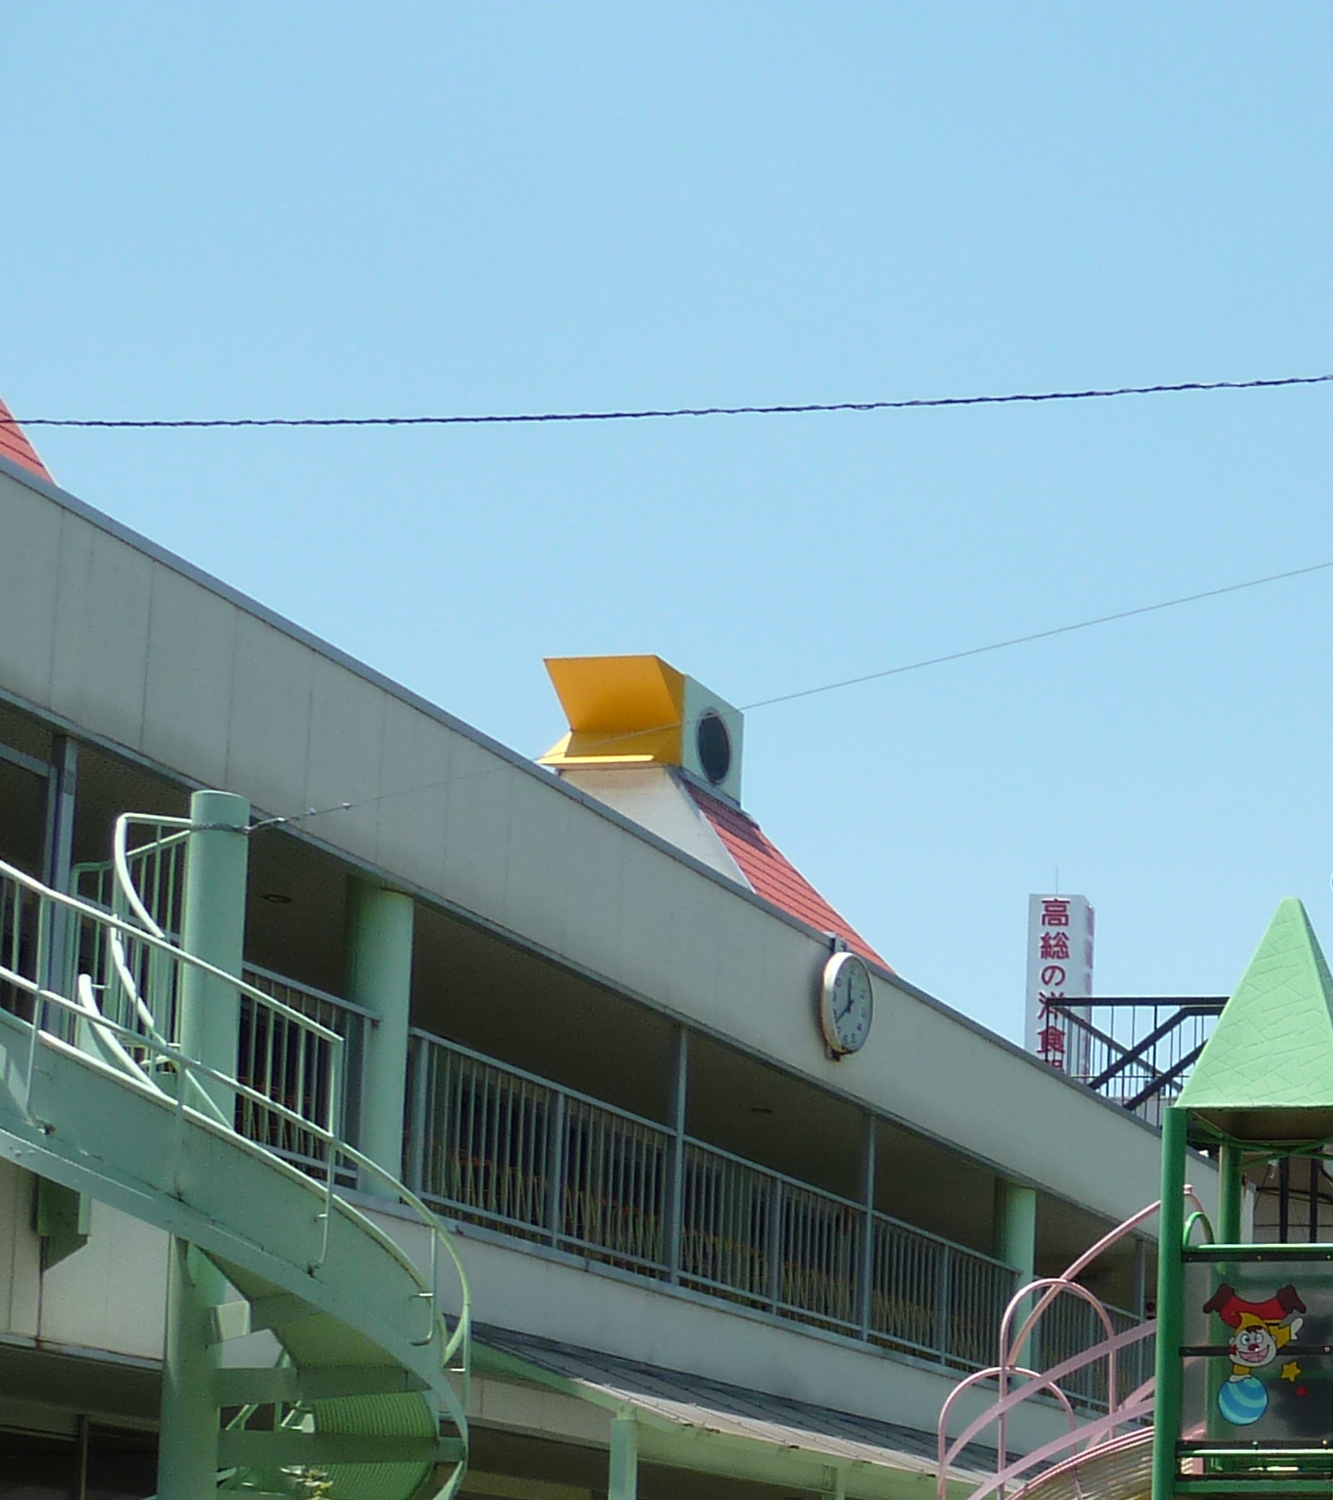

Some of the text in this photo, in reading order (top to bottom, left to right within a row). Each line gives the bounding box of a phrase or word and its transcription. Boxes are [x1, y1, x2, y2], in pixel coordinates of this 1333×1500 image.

[1036, 898, 1070, 1072] 高総の洋食
